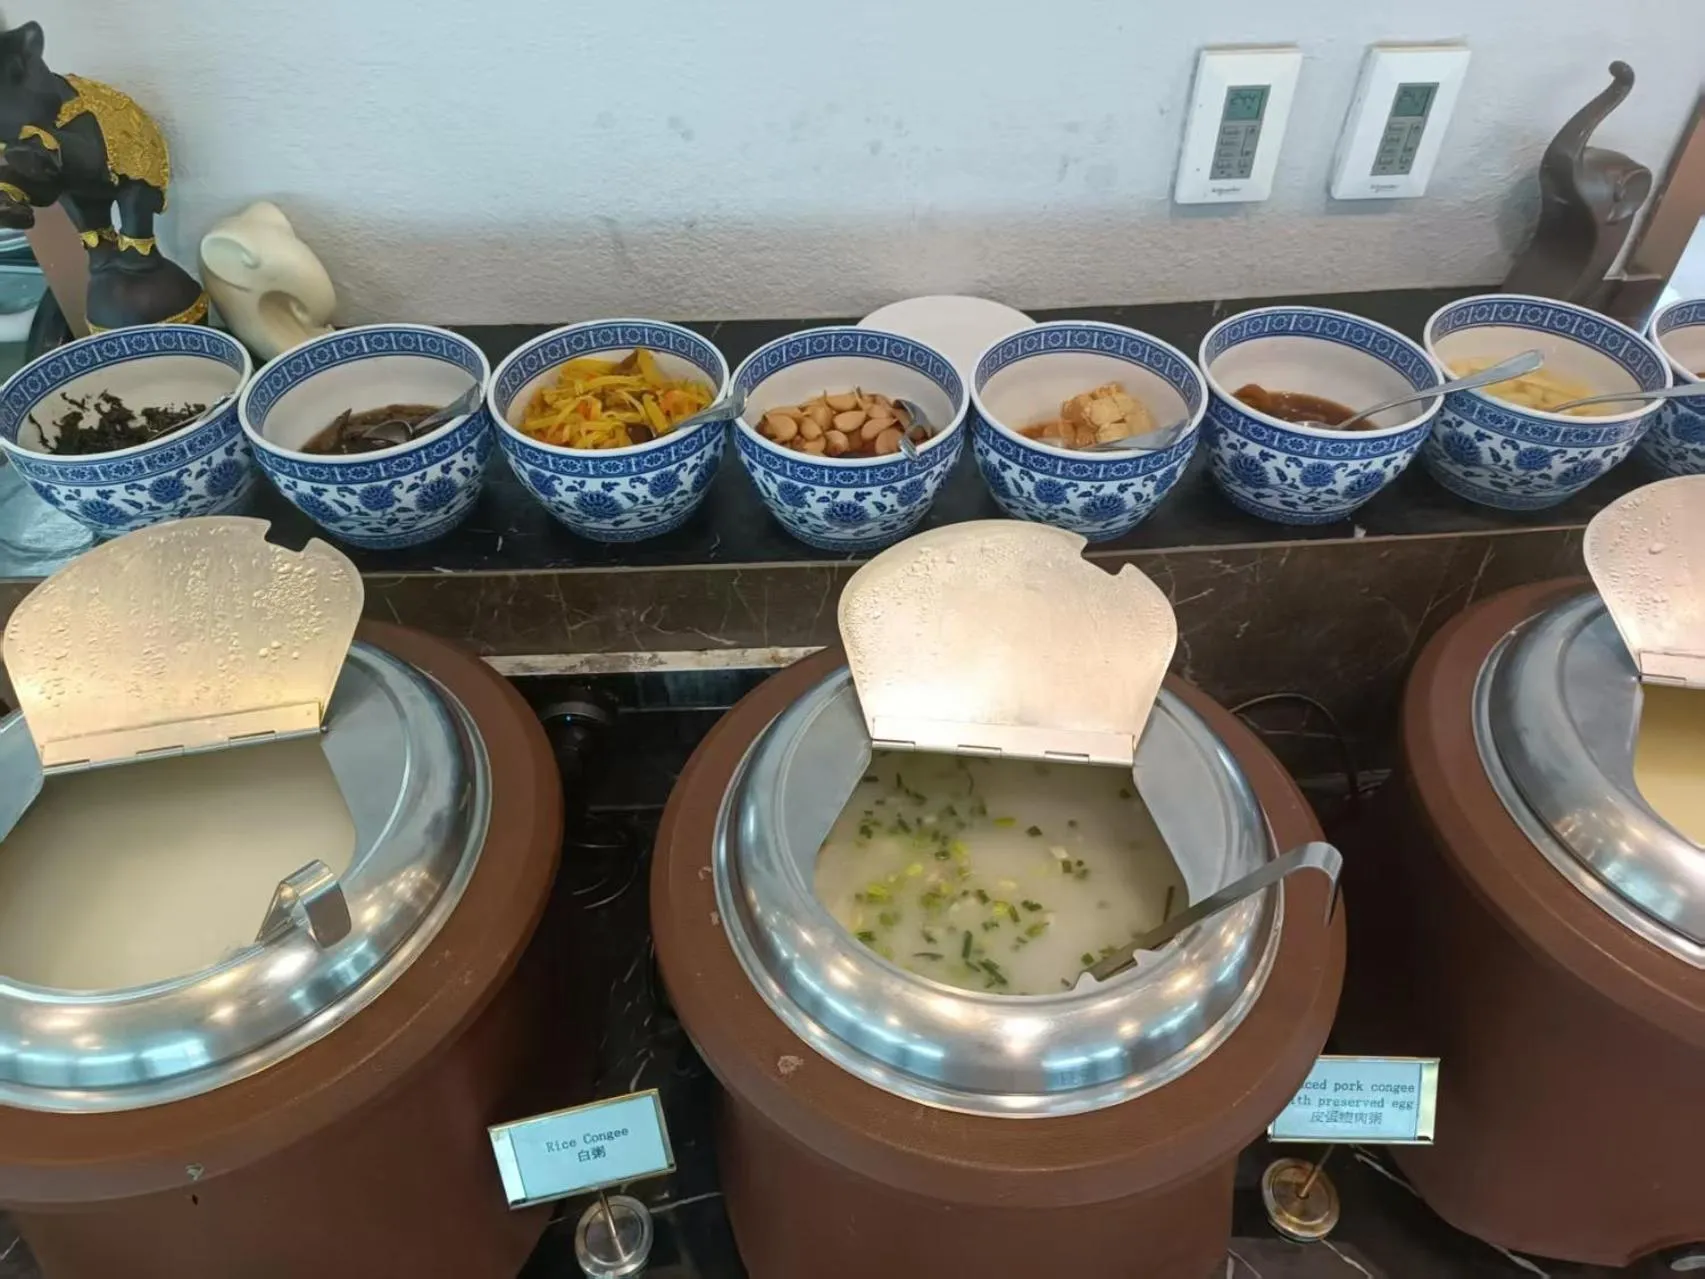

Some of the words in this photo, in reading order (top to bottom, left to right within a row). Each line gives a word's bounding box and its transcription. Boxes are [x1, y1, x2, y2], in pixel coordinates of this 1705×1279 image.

[1304, 1078, 1327, 1090] ced
[1333, 1079, 1364, 1093] pork
[1371, 1083, 1415, 1094] congee
[1318, 1097, 1384, 1108] preserved
[1392, 1100, 1414, 1111] egg
[545, 1138, 577, 1152] Rice
[582, 1127, 628, 1144] Congee
[577, 1145, 606, 1162] 白粥
